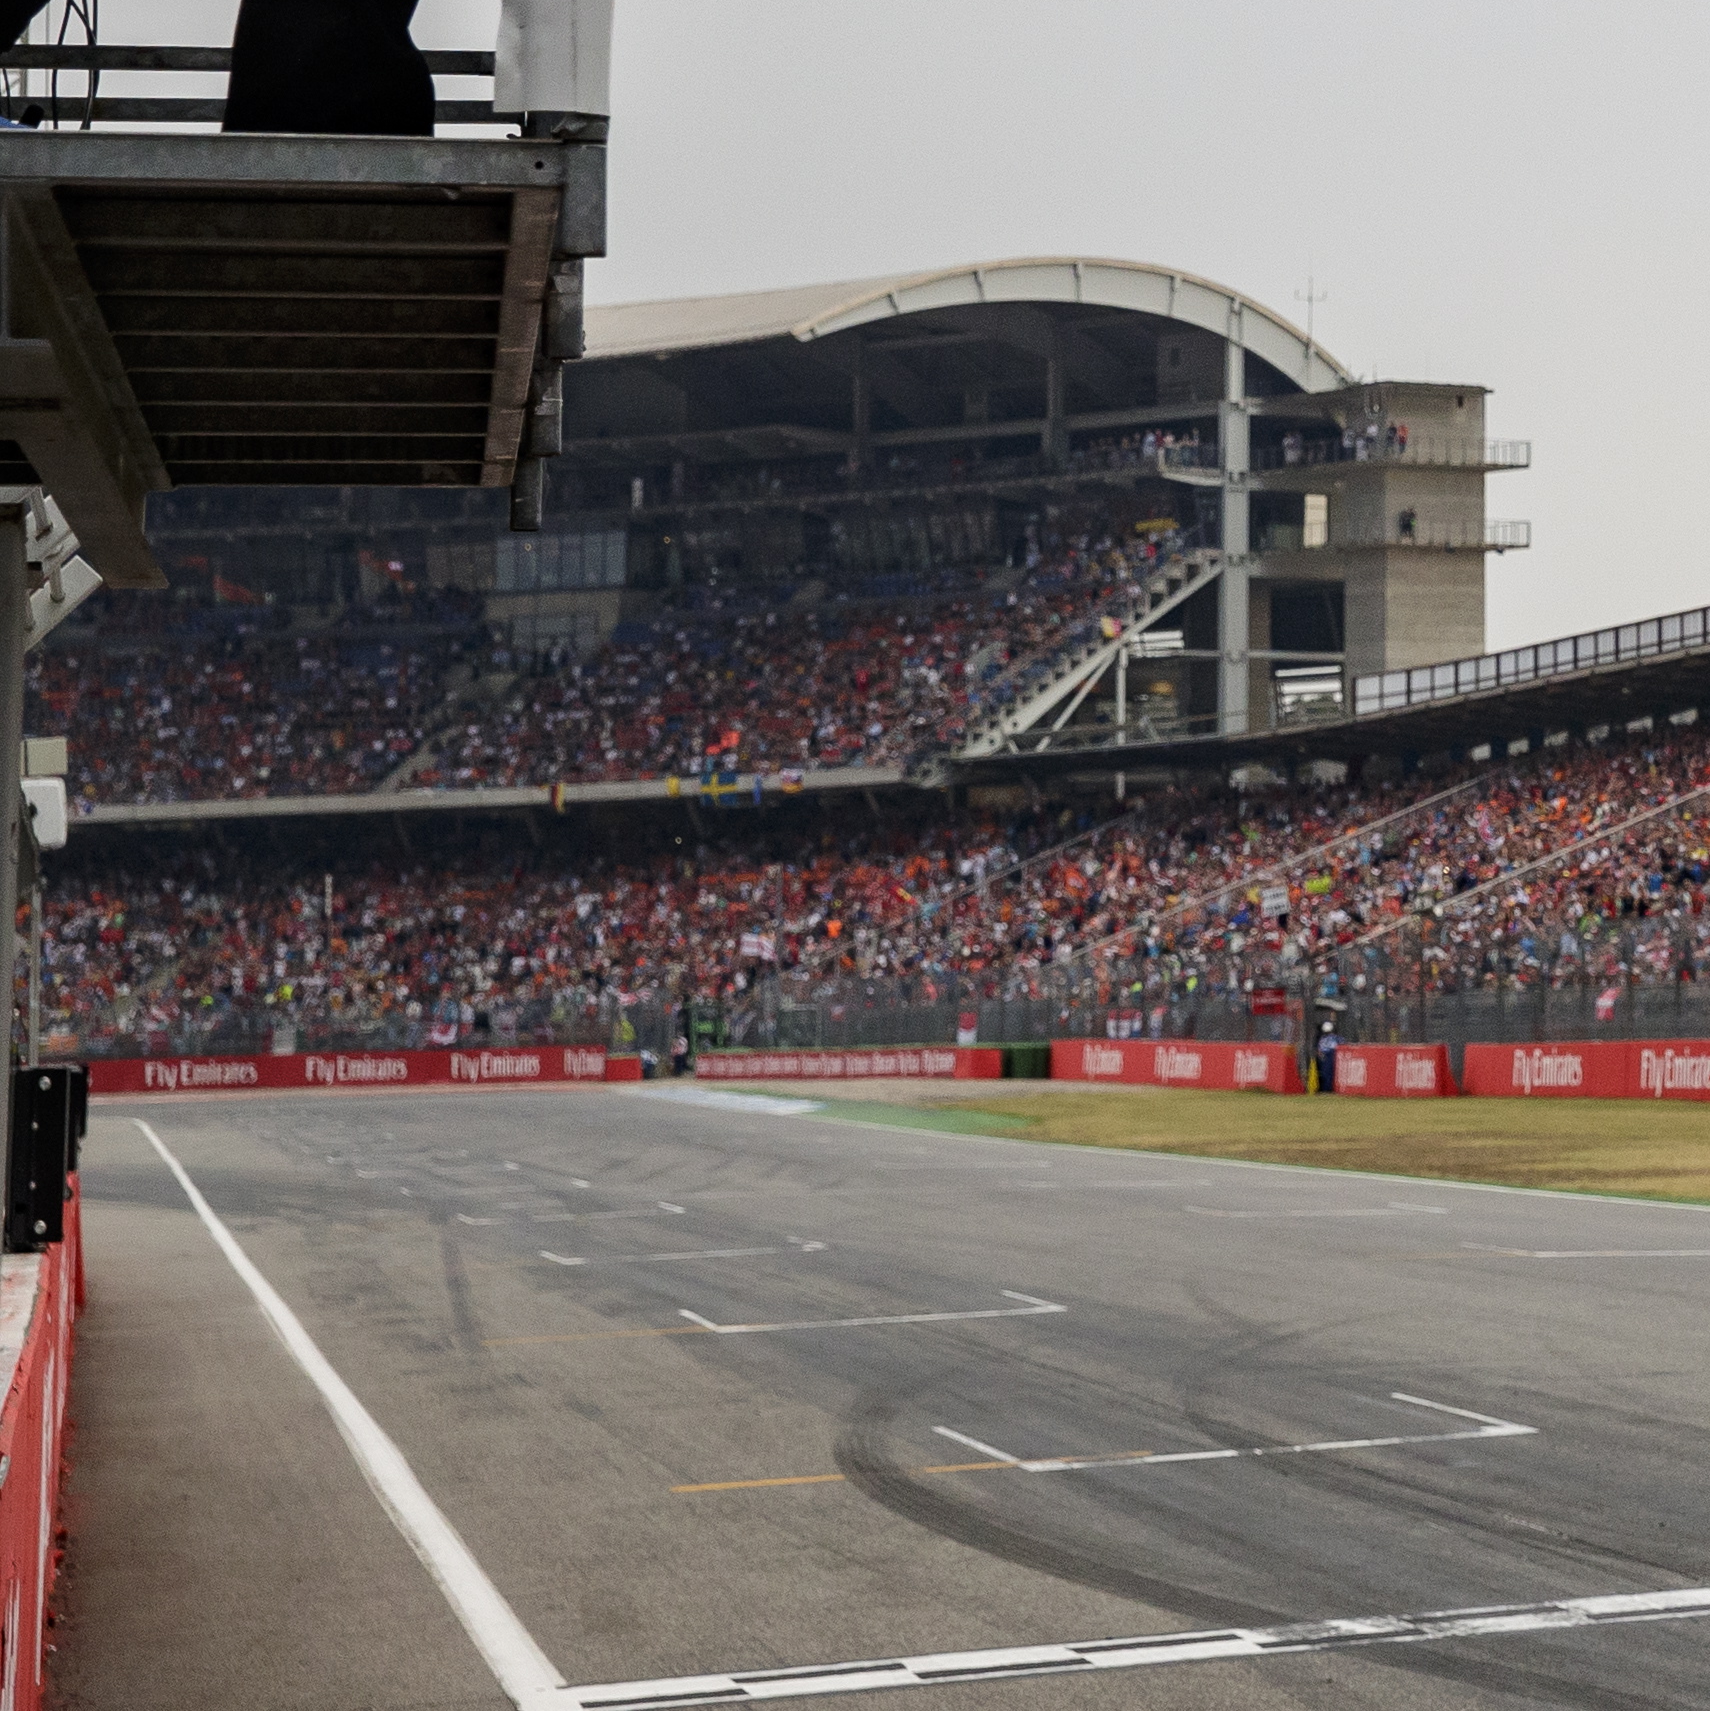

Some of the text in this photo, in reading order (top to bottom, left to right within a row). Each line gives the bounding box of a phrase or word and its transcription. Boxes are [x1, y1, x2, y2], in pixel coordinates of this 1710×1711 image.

[144, 1058, 258, 1091] Fly Emirates
[304, 1054, 407, 1086] Fly Emirates
[451, 1050, 540, 1084] Fly Emirates
[1512, 1047, 1583, 1094] Fly Emirates
[1640, 1048, 1662, 1098] Fly
